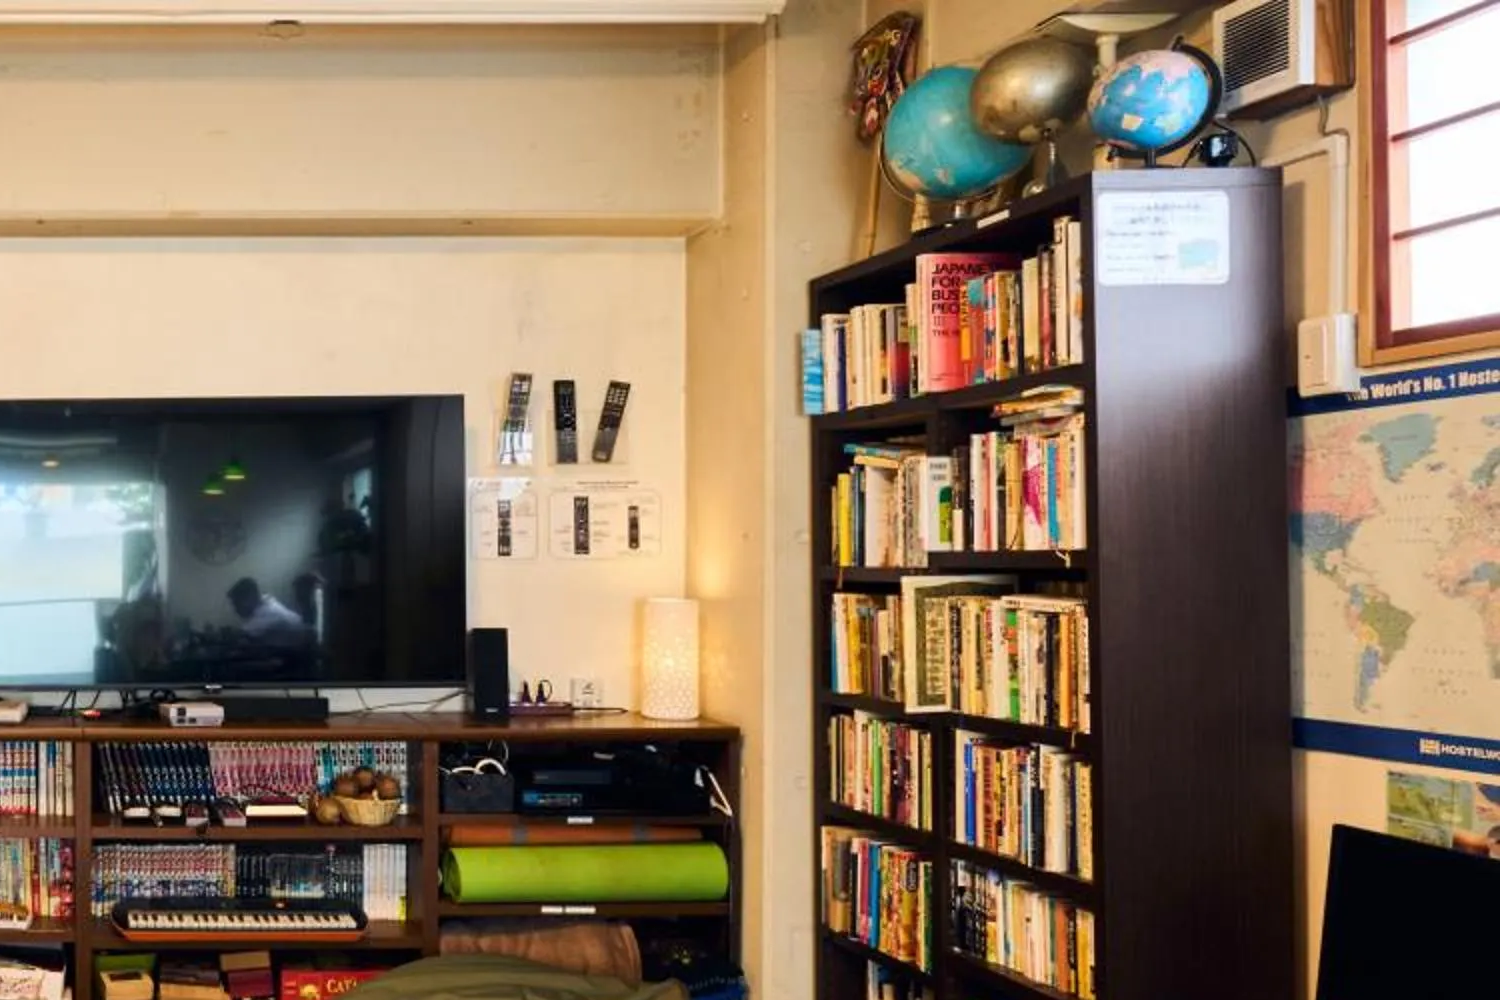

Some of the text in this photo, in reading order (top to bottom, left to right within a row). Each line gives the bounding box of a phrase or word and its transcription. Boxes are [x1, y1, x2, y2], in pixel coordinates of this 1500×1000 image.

[932, 263, 991, 274] JAPANE
[932, 275, 961, 288] FOR
[932, 289, 960, 301] BUS
[932, 303, 960, 314] PEO
[1370, 379, 1421, 398] World's
[1423, 375, 1447, 392] No.
[1448, 373, 1456, 388] 1
[326, 976, 358, 993] CAT
